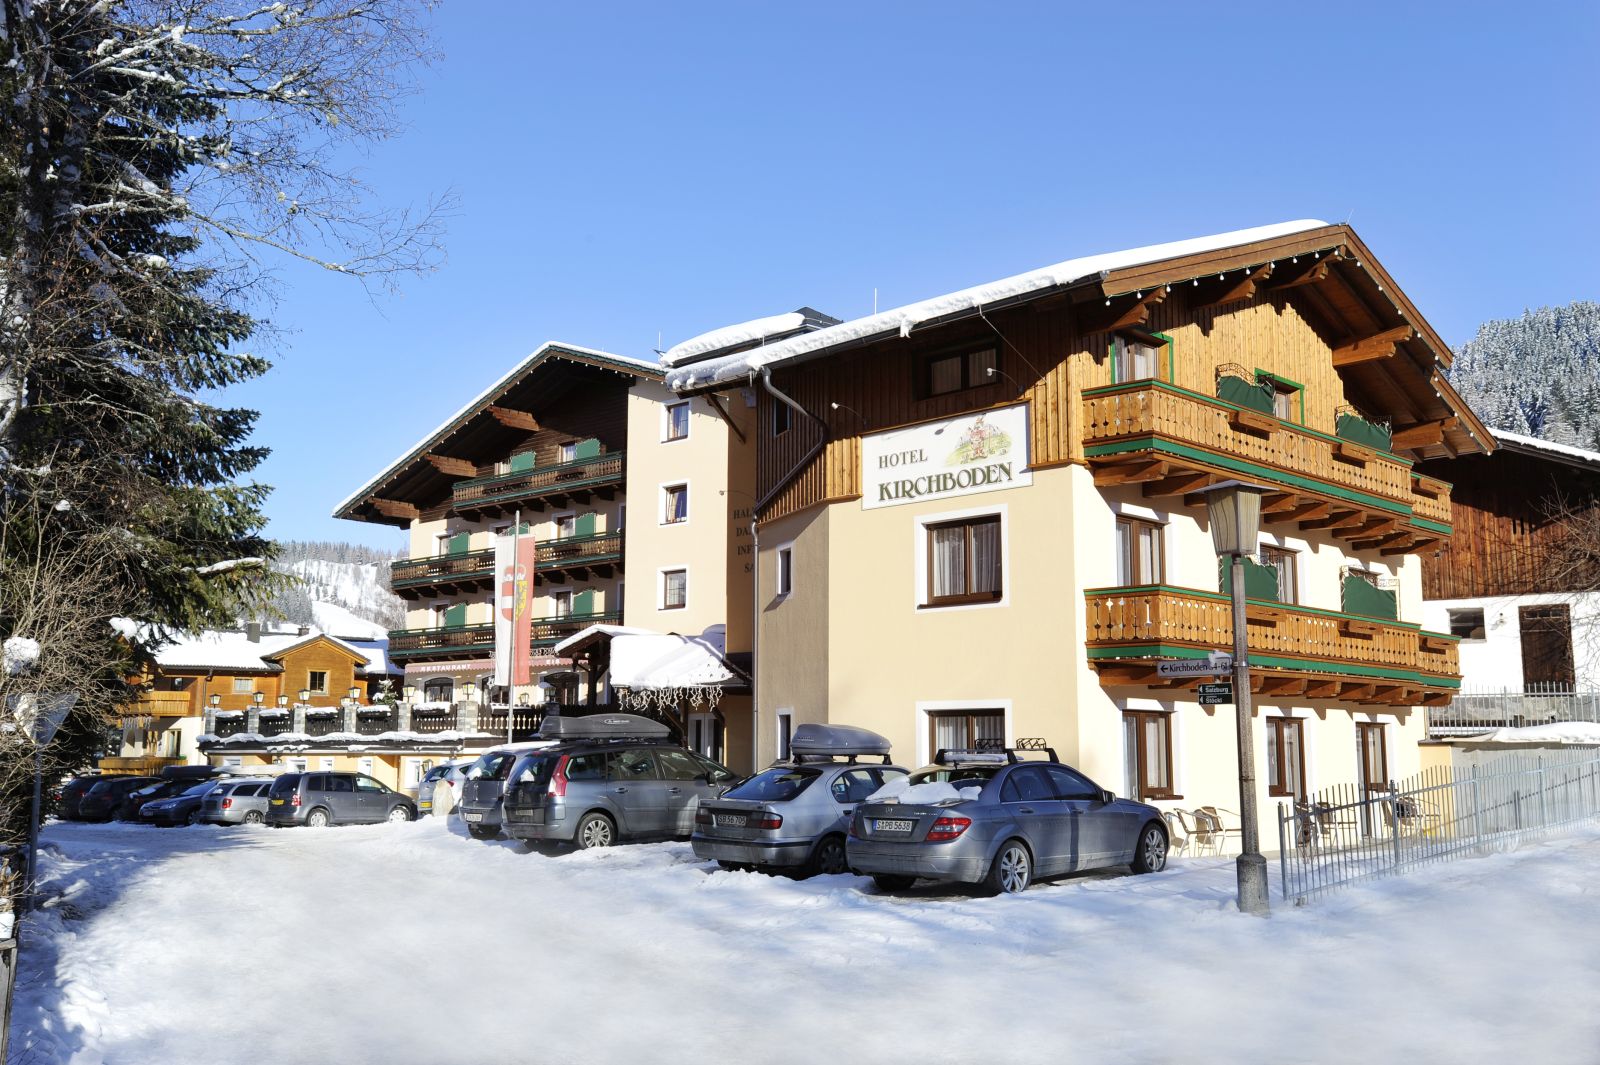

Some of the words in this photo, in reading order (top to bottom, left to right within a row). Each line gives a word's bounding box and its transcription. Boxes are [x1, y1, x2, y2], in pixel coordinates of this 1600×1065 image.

[878, 448, 928, 469] HOTEL
[878, 462, 1013, 502] KIRCHBODEN
[420, 663, 472, 672] RESTAURANT
[1169, 662, 1208, 673] Kirchboden
